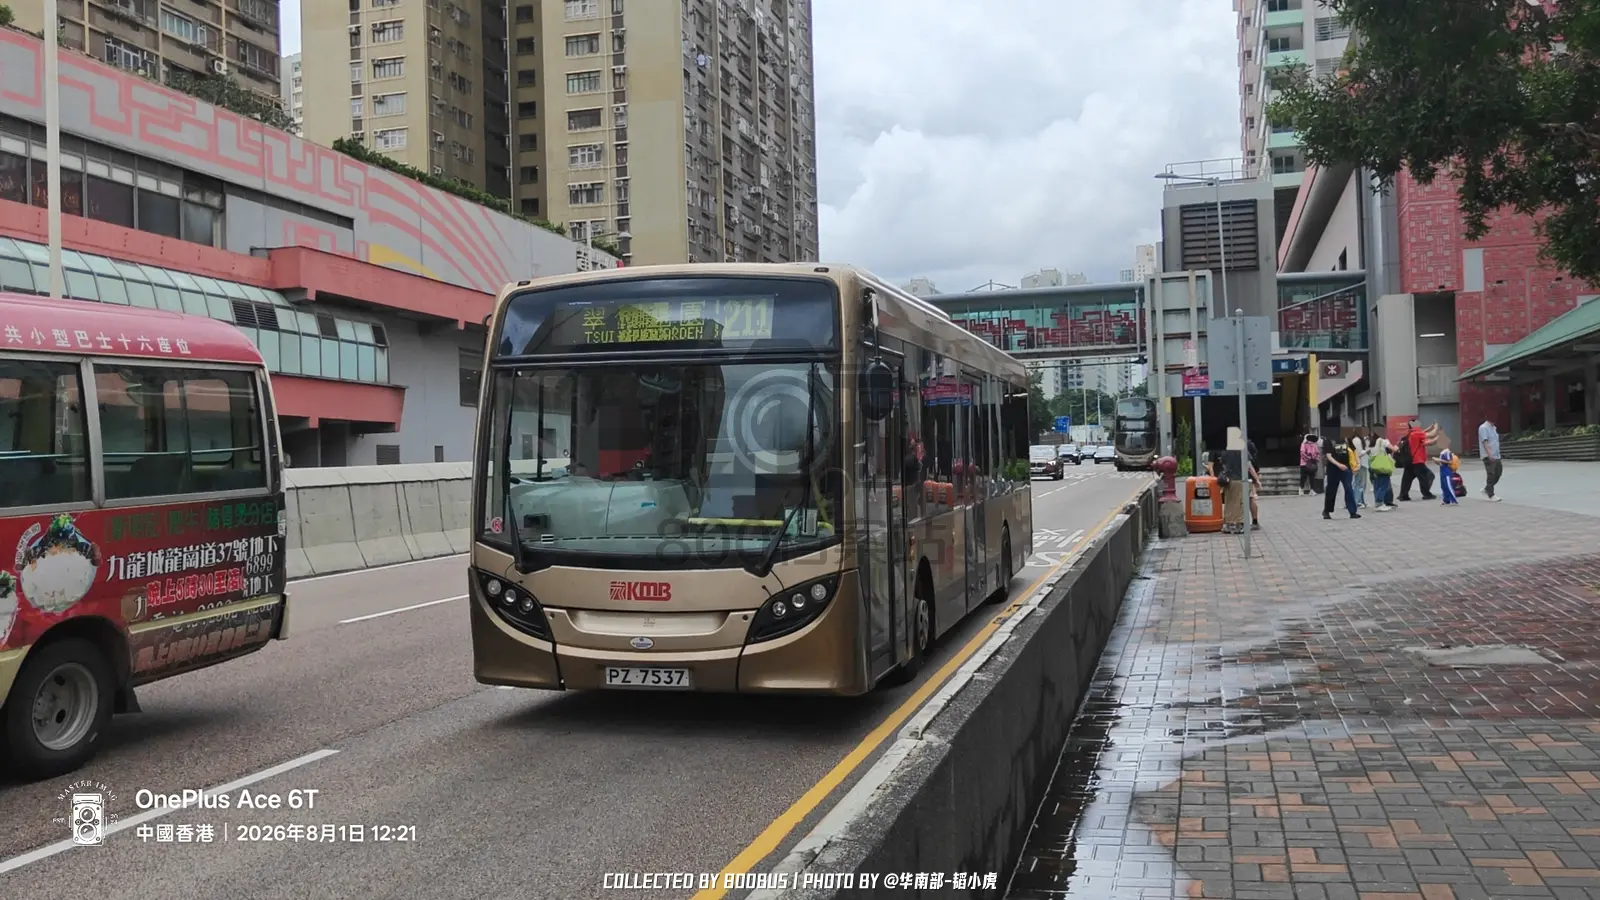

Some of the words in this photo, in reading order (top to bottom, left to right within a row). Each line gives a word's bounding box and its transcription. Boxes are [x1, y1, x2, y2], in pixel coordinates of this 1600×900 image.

[723, 299, 769, 337] 211
[4, 325, 191, 354] 共小型巴士十六座位
[584, 330, 614, 344] TSUI
[246, 553, 274, 574] 6899
[627, 581, 672, 602] KMB
[609, 669, 631, 684] PZ
[639, 669, 686, 685] 7537
